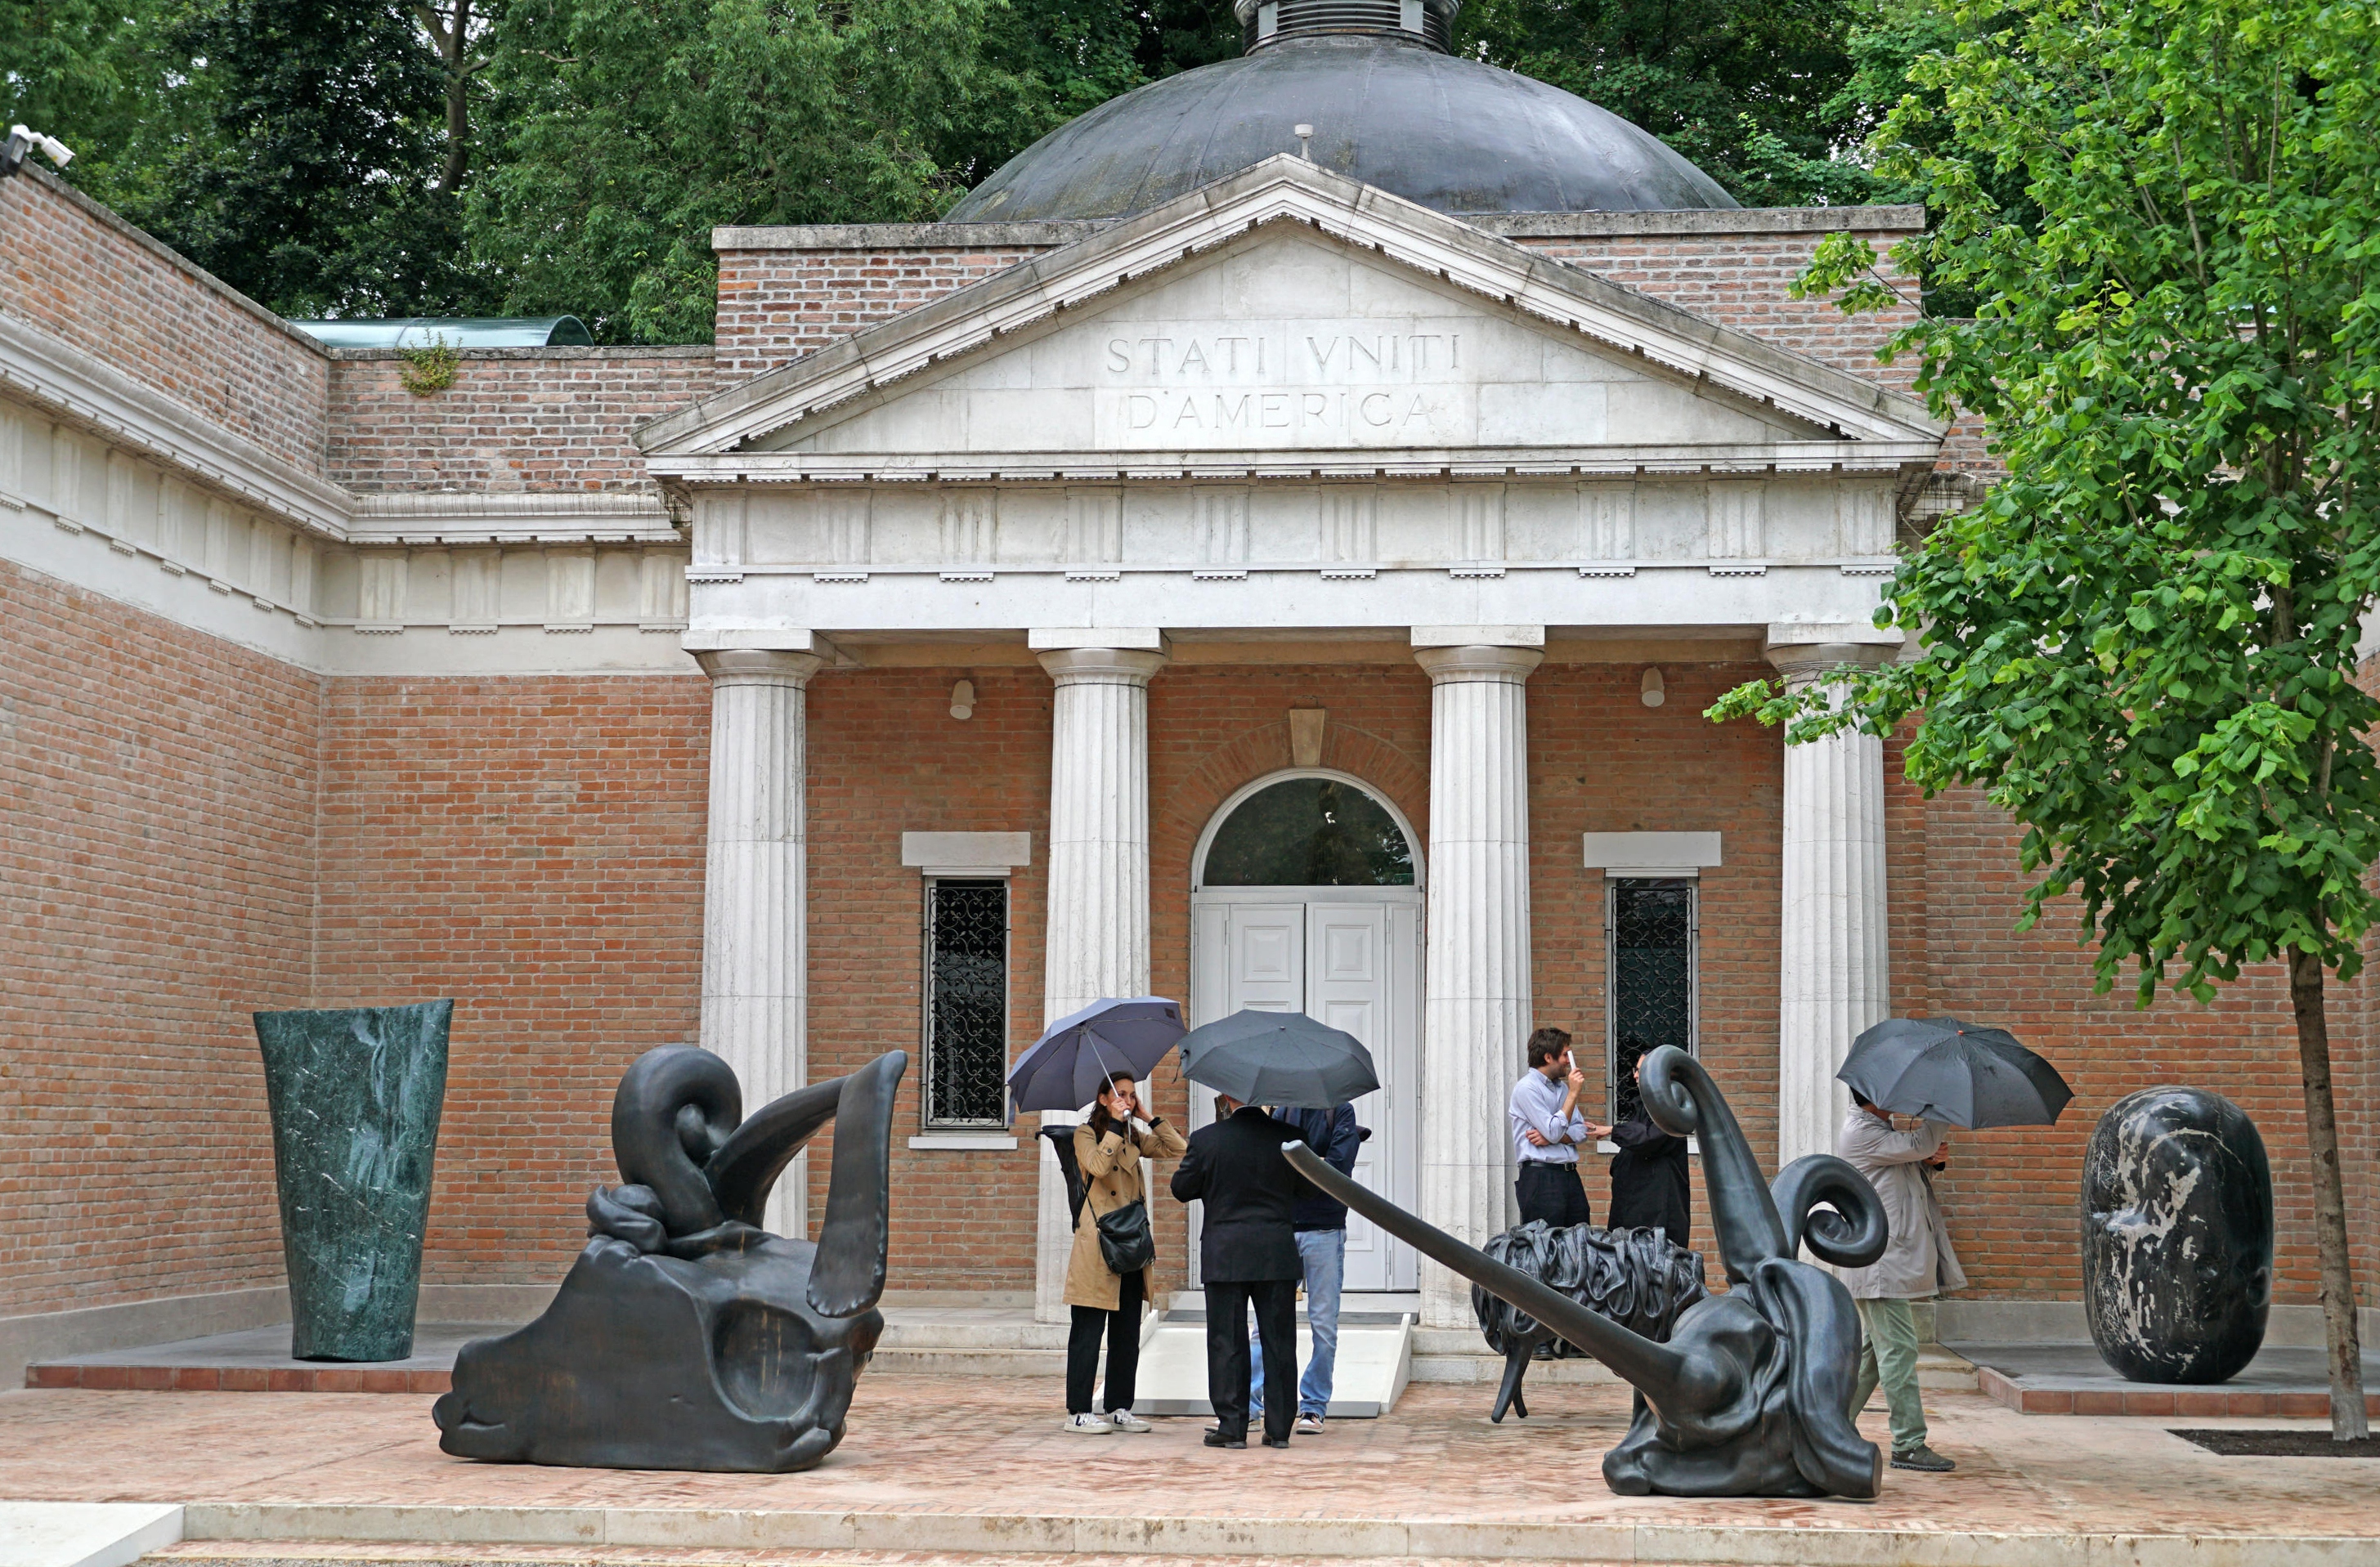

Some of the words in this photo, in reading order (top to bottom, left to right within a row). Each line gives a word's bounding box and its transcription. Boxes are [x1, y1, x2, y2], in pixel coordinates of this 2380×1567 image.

[1107, 337, 1267, 374] STATI
[1307, 334, 1460, 373] VNITI
[1128, 391, 1437, 429] D'AMERICA
